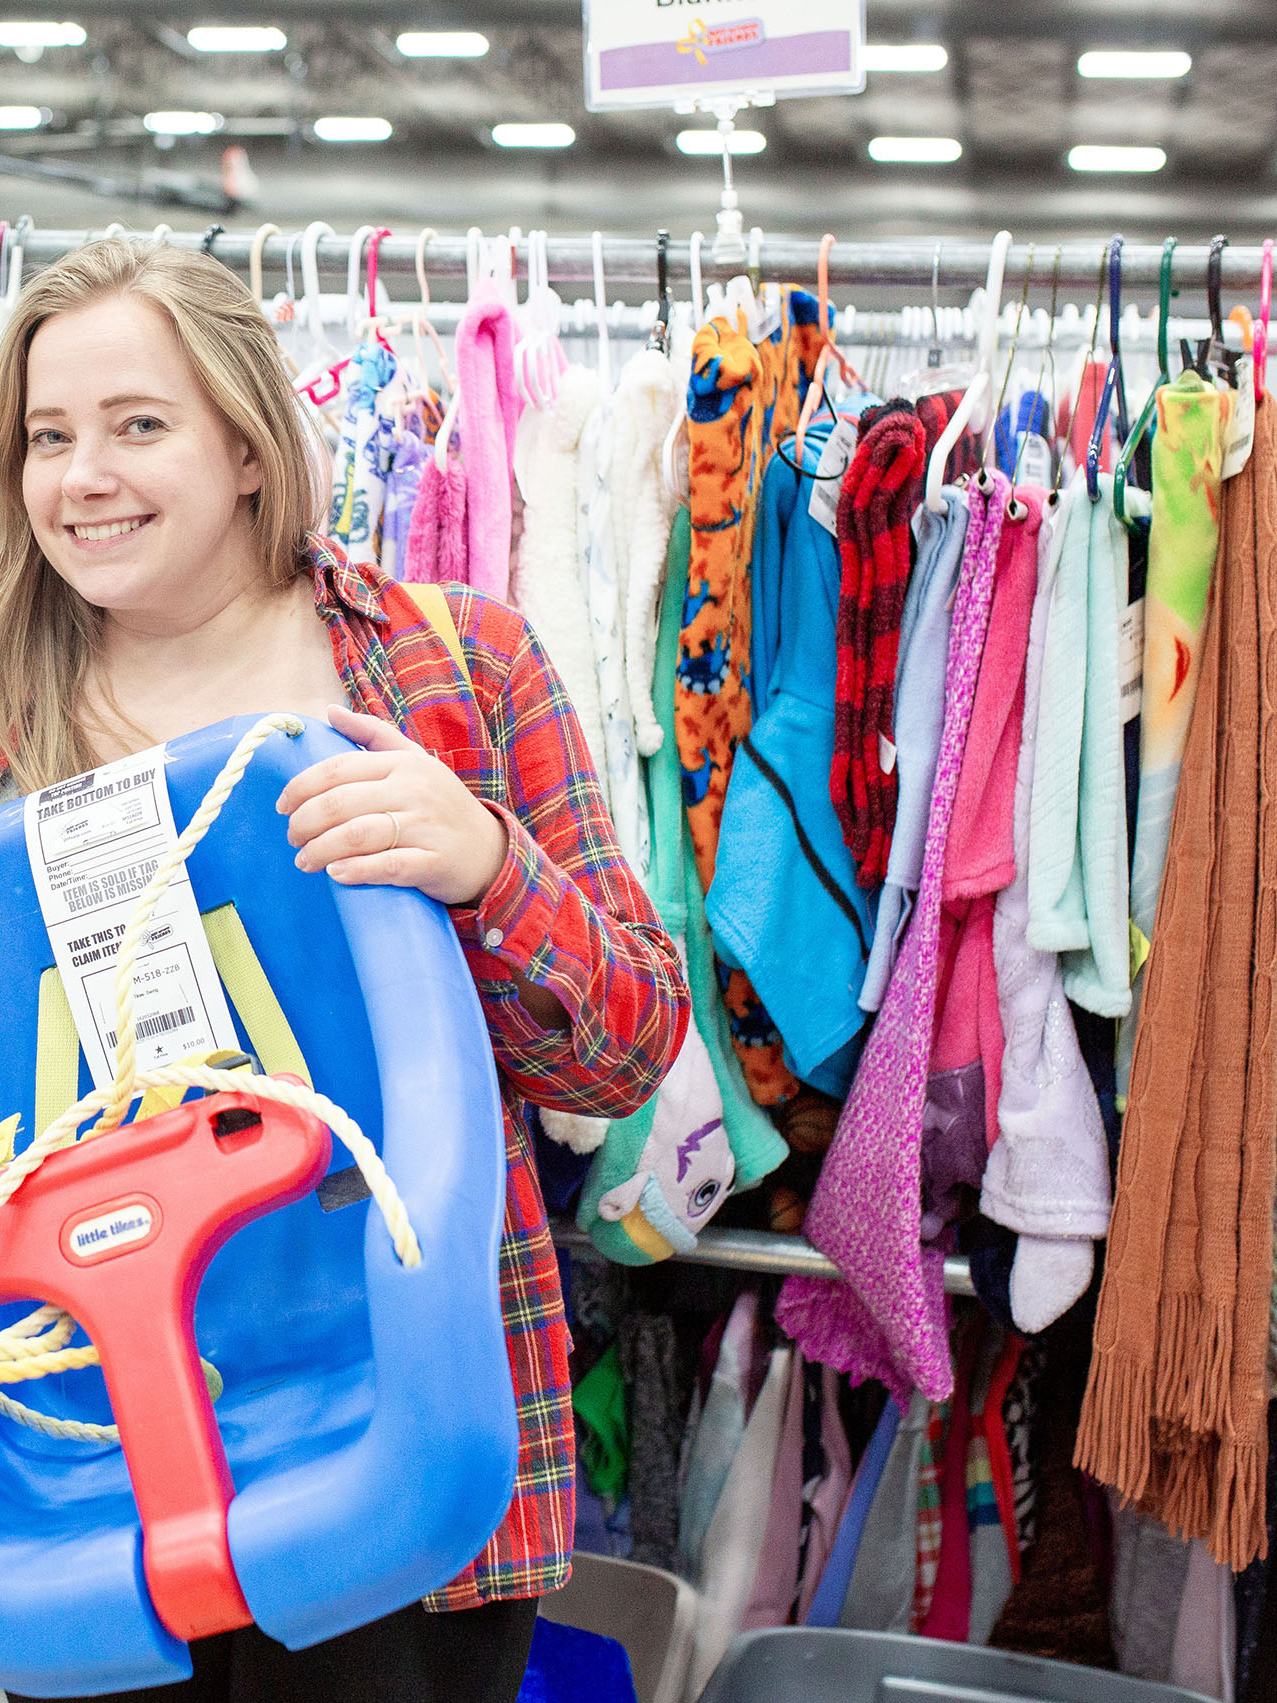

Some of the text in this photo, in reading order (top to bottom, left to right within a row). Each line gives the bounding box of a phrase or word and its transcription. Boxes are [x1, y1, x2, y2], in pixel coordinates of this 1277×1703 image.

[36, 801, 65, 820] TAKE
[66, 784, 114, 810] BOTTOM
[116, 777, 131, 792] TO
[133, 768, 156, 786] BUY
[46, 861, 70, 874] Buyer:
[48, 869, 74, 882] Phone:
[50, 873, 89, 891] Date/Time:
[62, 859, 159, 902] ITEM IS SOLD IF TAG
[68, 873, 156, 913] BELOW IS MISSIN
[67, 923, 127, 953] TAKE THIS TO
[71, 949, 102, 968] CLAIM
[182, 1037, 205, 1050] $10.00
[76, 1228, 108, 1247] little
